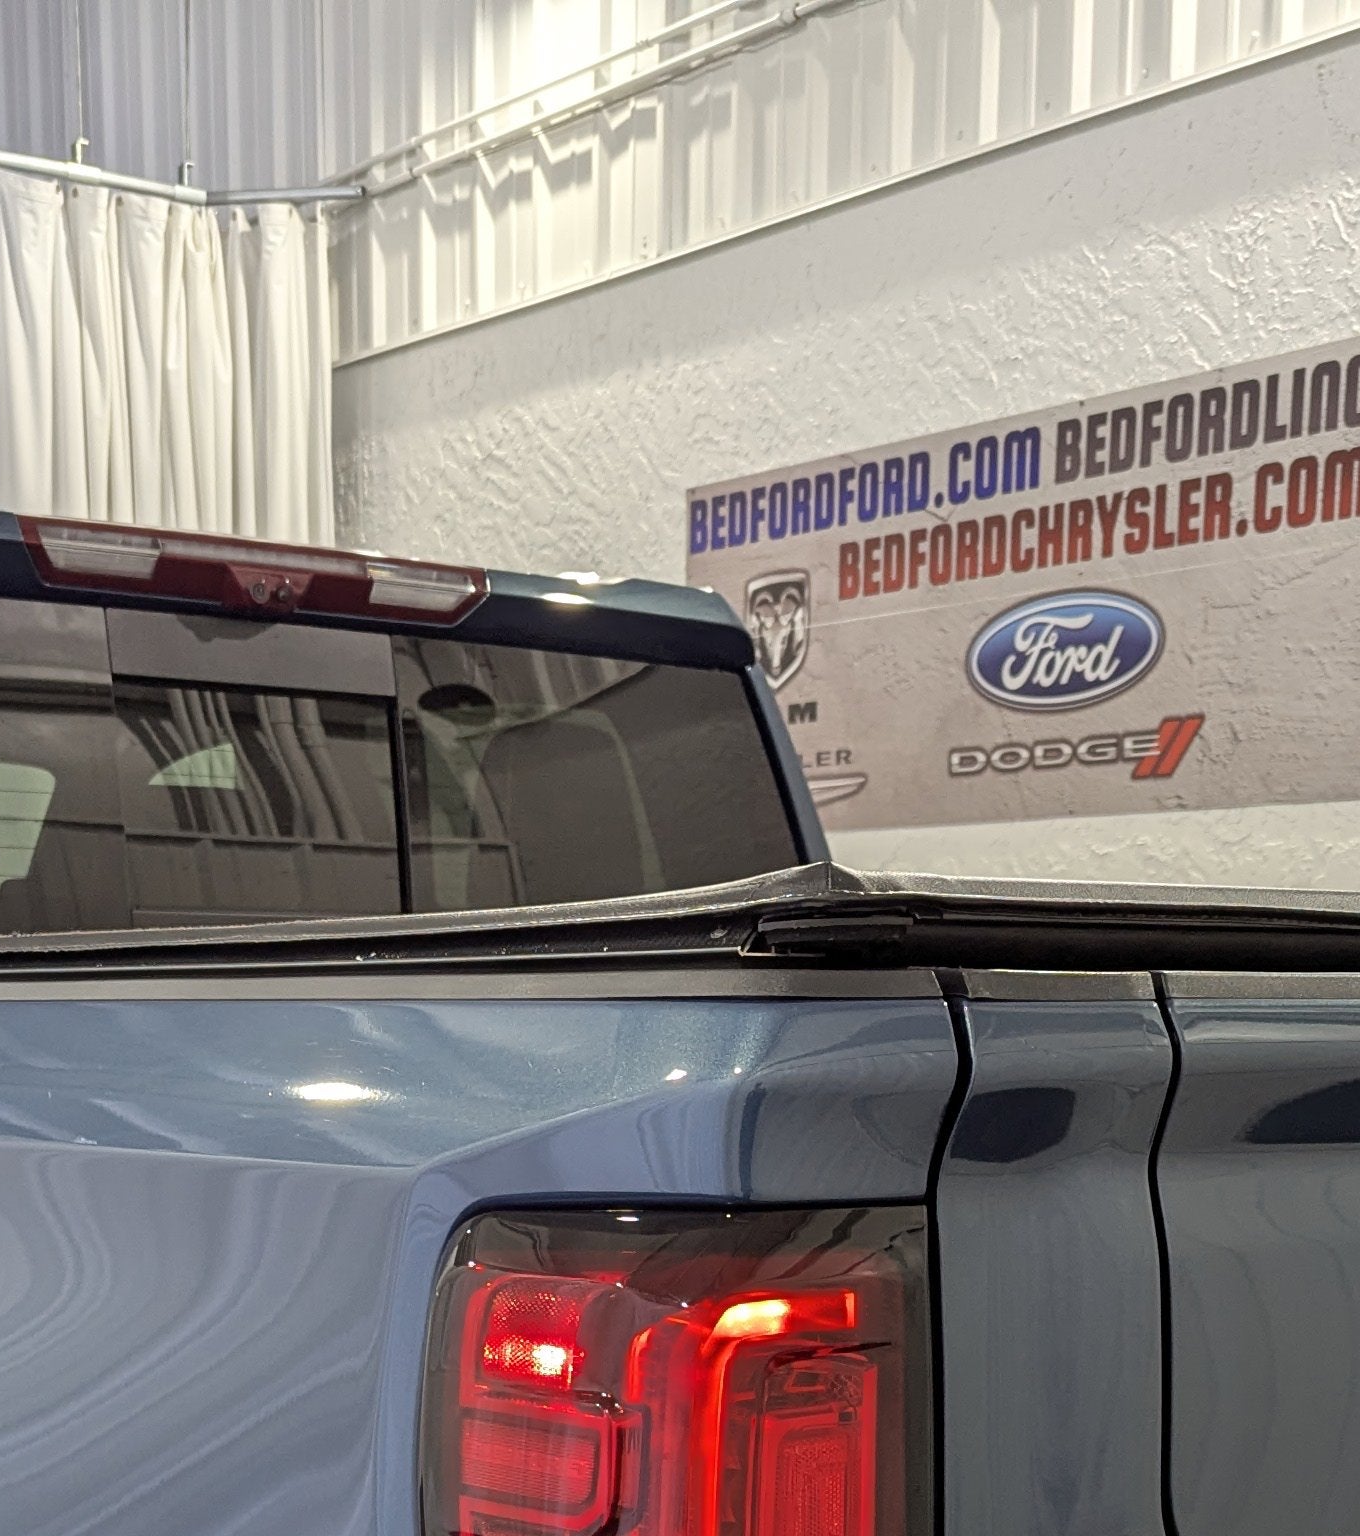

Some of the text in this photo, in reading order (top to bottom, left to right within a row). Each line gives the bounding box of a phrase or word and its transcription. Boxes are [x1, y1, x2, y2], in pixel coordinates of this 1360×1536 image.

[690, 426, 1041, 555] BEDFORDFORD.COM
[1001, 613, 1125, 690] Ford
[948, 729, 1161, 778] DODGE
